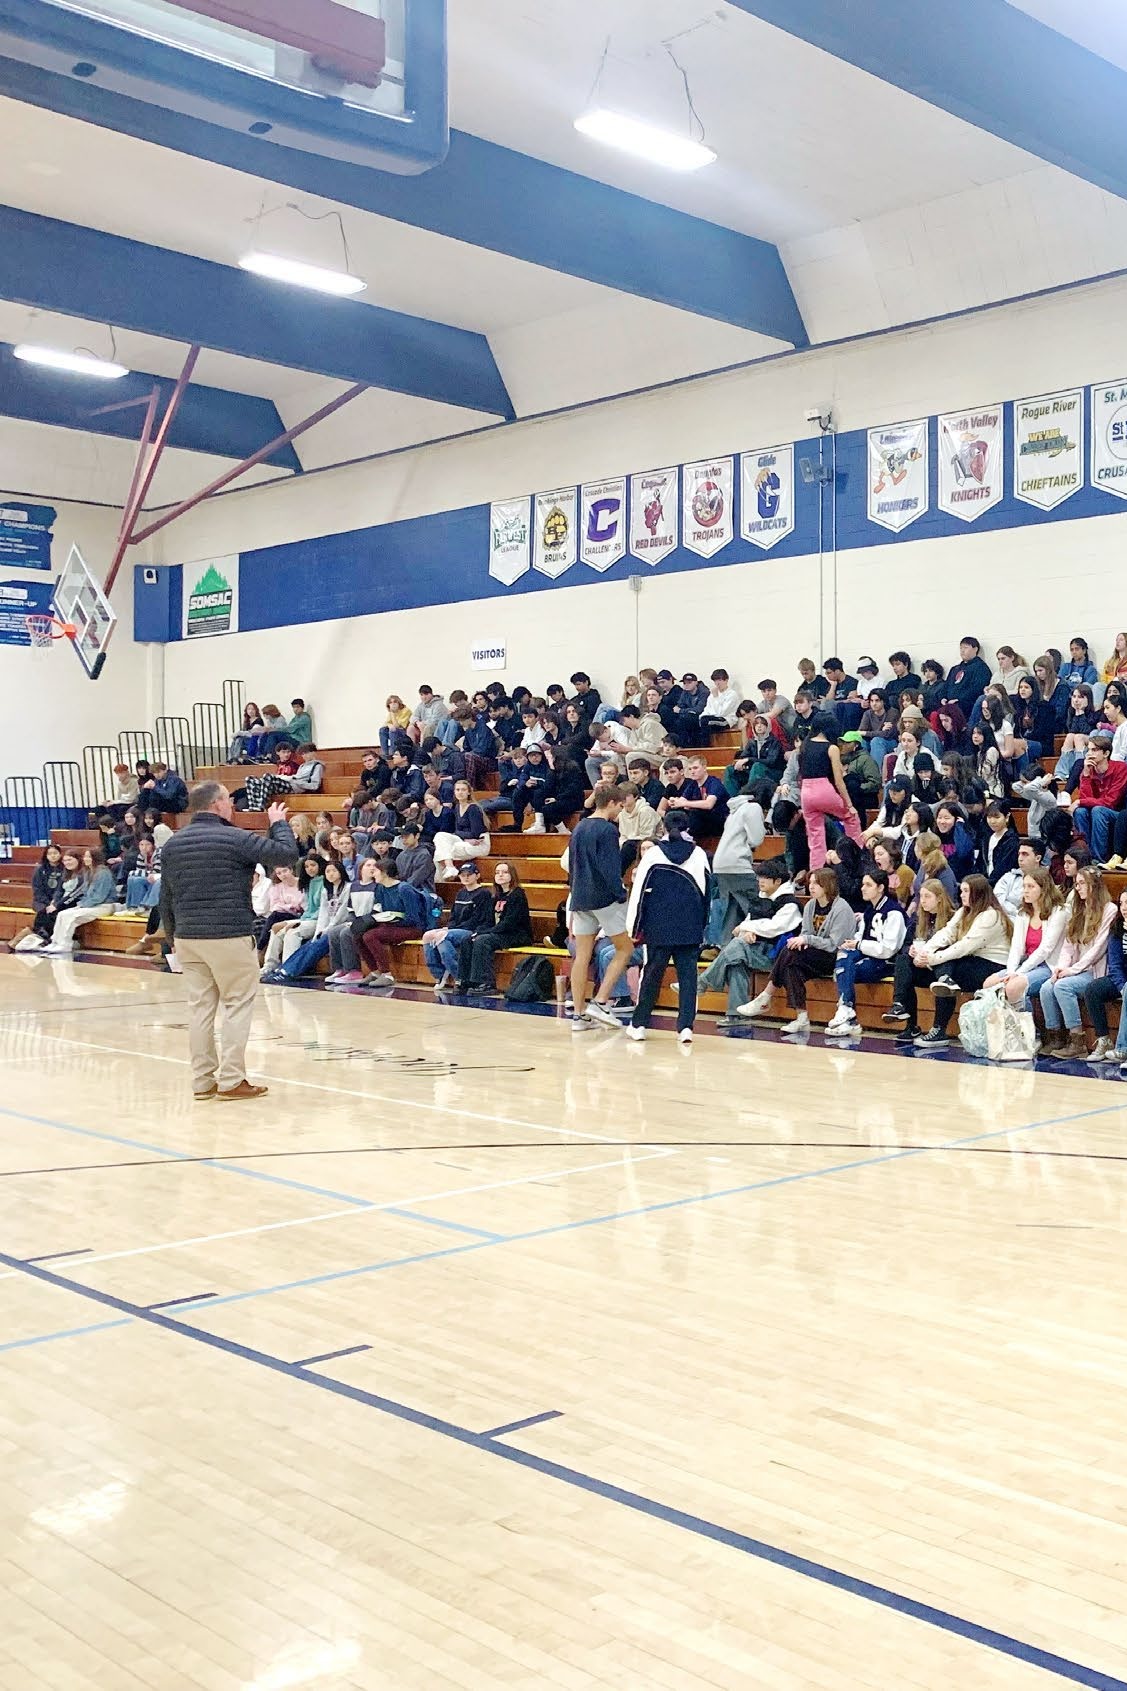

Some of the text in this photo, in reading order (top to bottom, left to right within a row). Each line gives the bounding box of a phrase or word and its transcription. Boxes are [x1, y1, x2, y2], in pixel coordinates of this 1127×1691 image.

[1104, 392, 1117, 403] St.
[1021, 400, 1077, 420] Rogue River
[970, 413, 998, 430] Valley
[1021, 474, 1077, 492] CHIEFTAINS
[950, 486, 991, 503] KNIGHTS
[747, 518, 788, 534] WILDCATS
[635, 535, 673, 550] RED DEVILS
[692, 528, 724, 542] TROJANS
[472, 647, 505, 660] VISITORS
